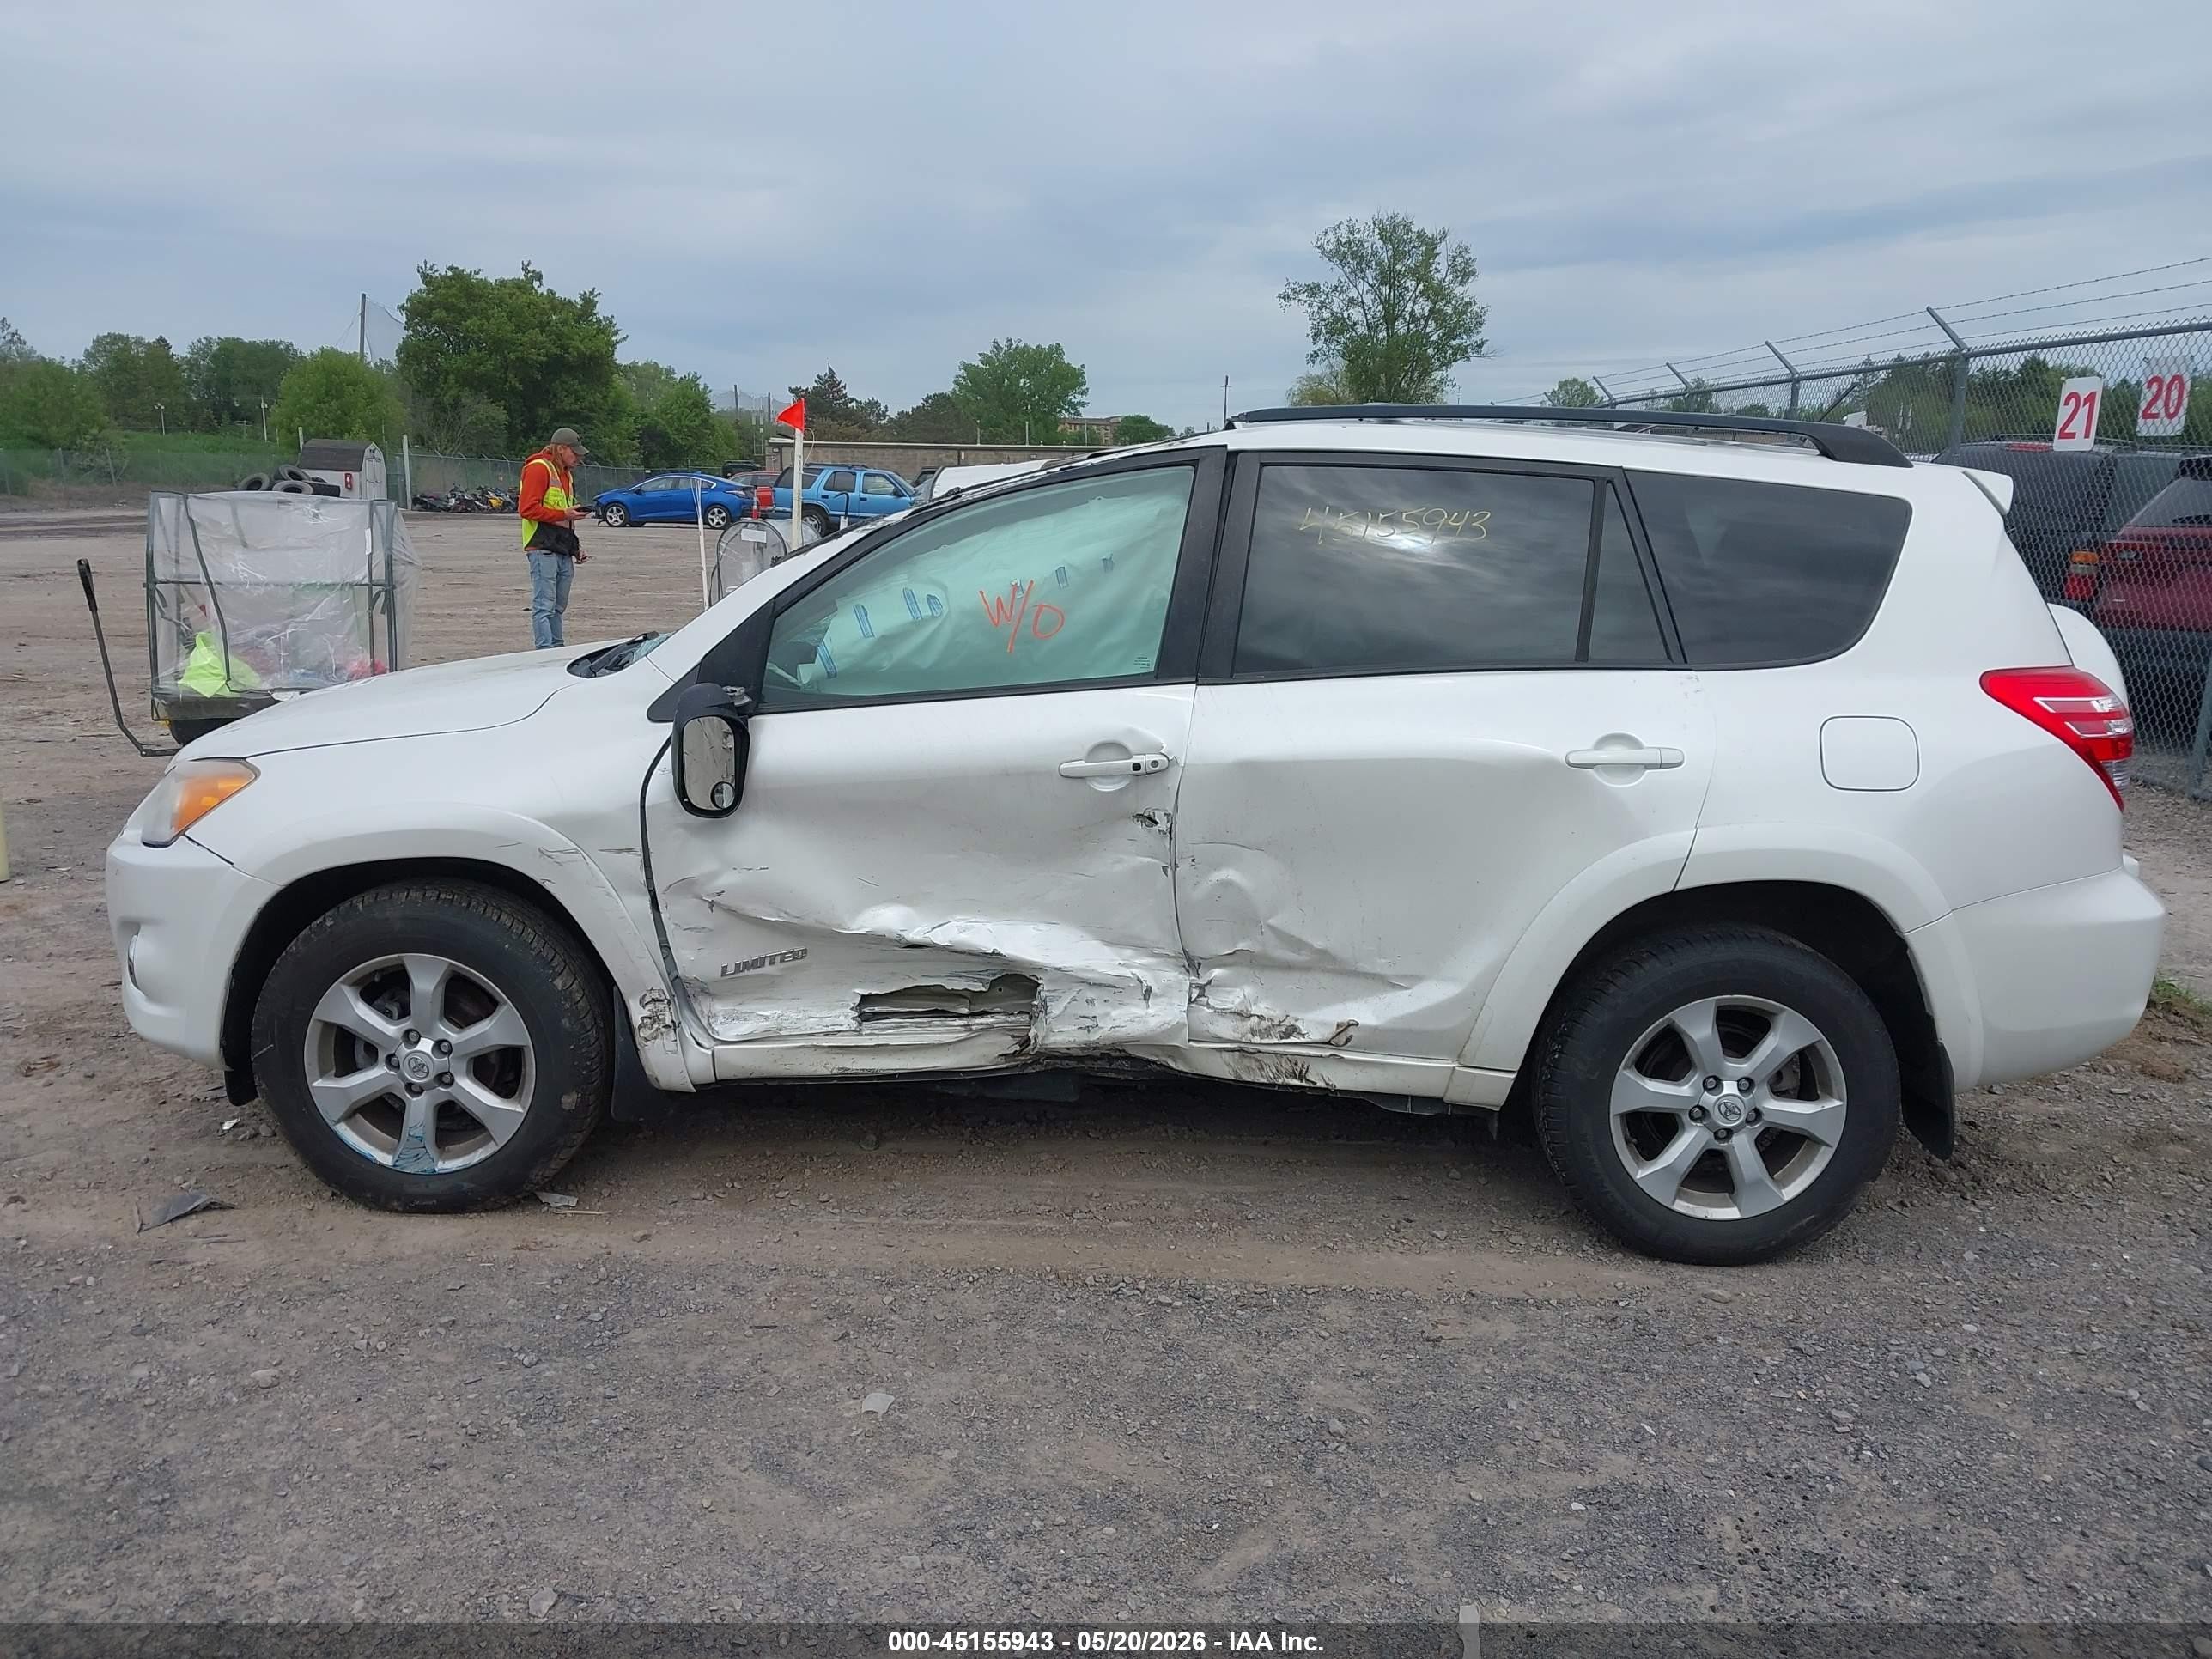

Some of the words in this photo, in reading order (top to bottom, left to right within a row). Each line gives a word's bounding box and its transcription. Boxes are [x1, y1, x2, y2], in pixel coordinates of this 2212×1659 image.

[2057, 392, 2097, 440] 21
[2142, 374, 2185, 420] 20
[1298, 506, 1492, 544] 45155943
[978, 579, 1066, 653] W/O
[720, 946, 808, 977] LIMITED
